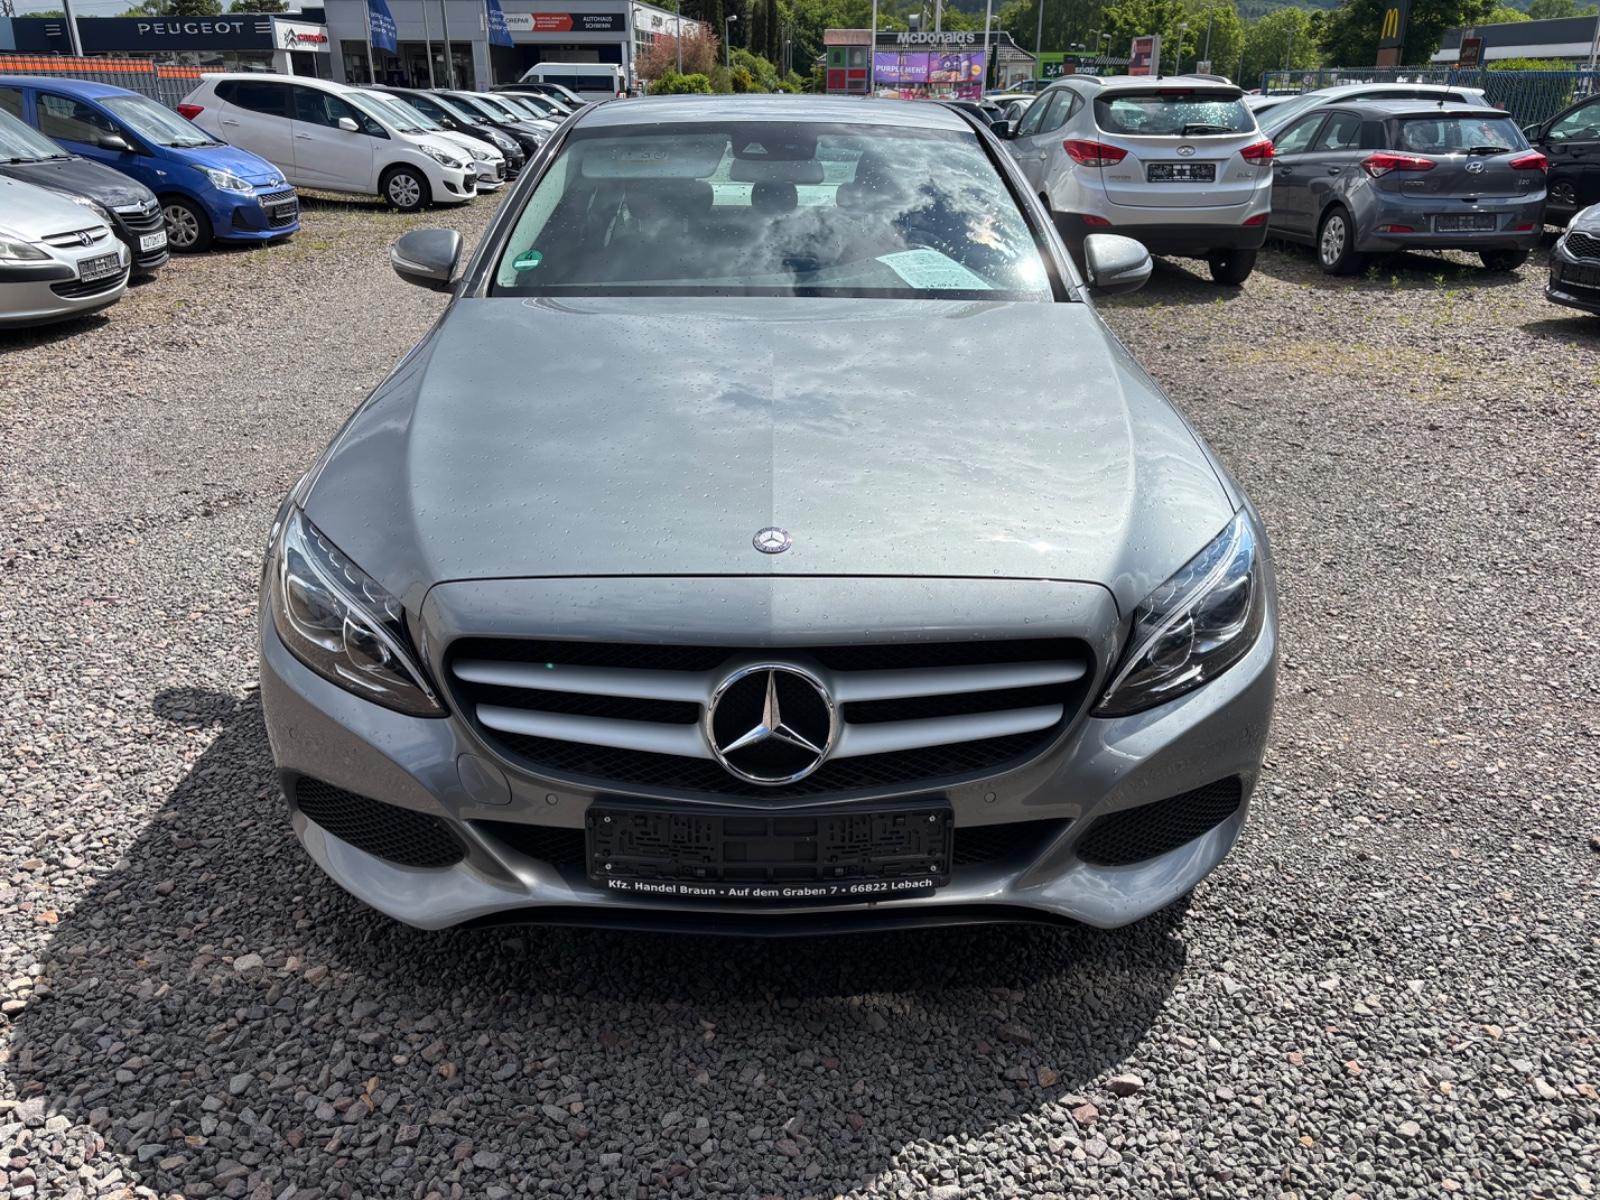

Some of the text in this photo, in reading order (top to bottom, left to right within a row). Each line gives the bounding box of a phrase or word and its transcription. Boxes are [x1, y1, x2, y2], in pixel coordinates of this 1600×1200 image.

[137, 21, 244, 35] PEUGEOT
[897, 31, 976, 44] McDonald's
[875, 64, 928, 74] PURPLE MENÜ
[608, 878, 934, 898] Kfz. Handel Braun Auf dem Graben 7 66822 Lebach
